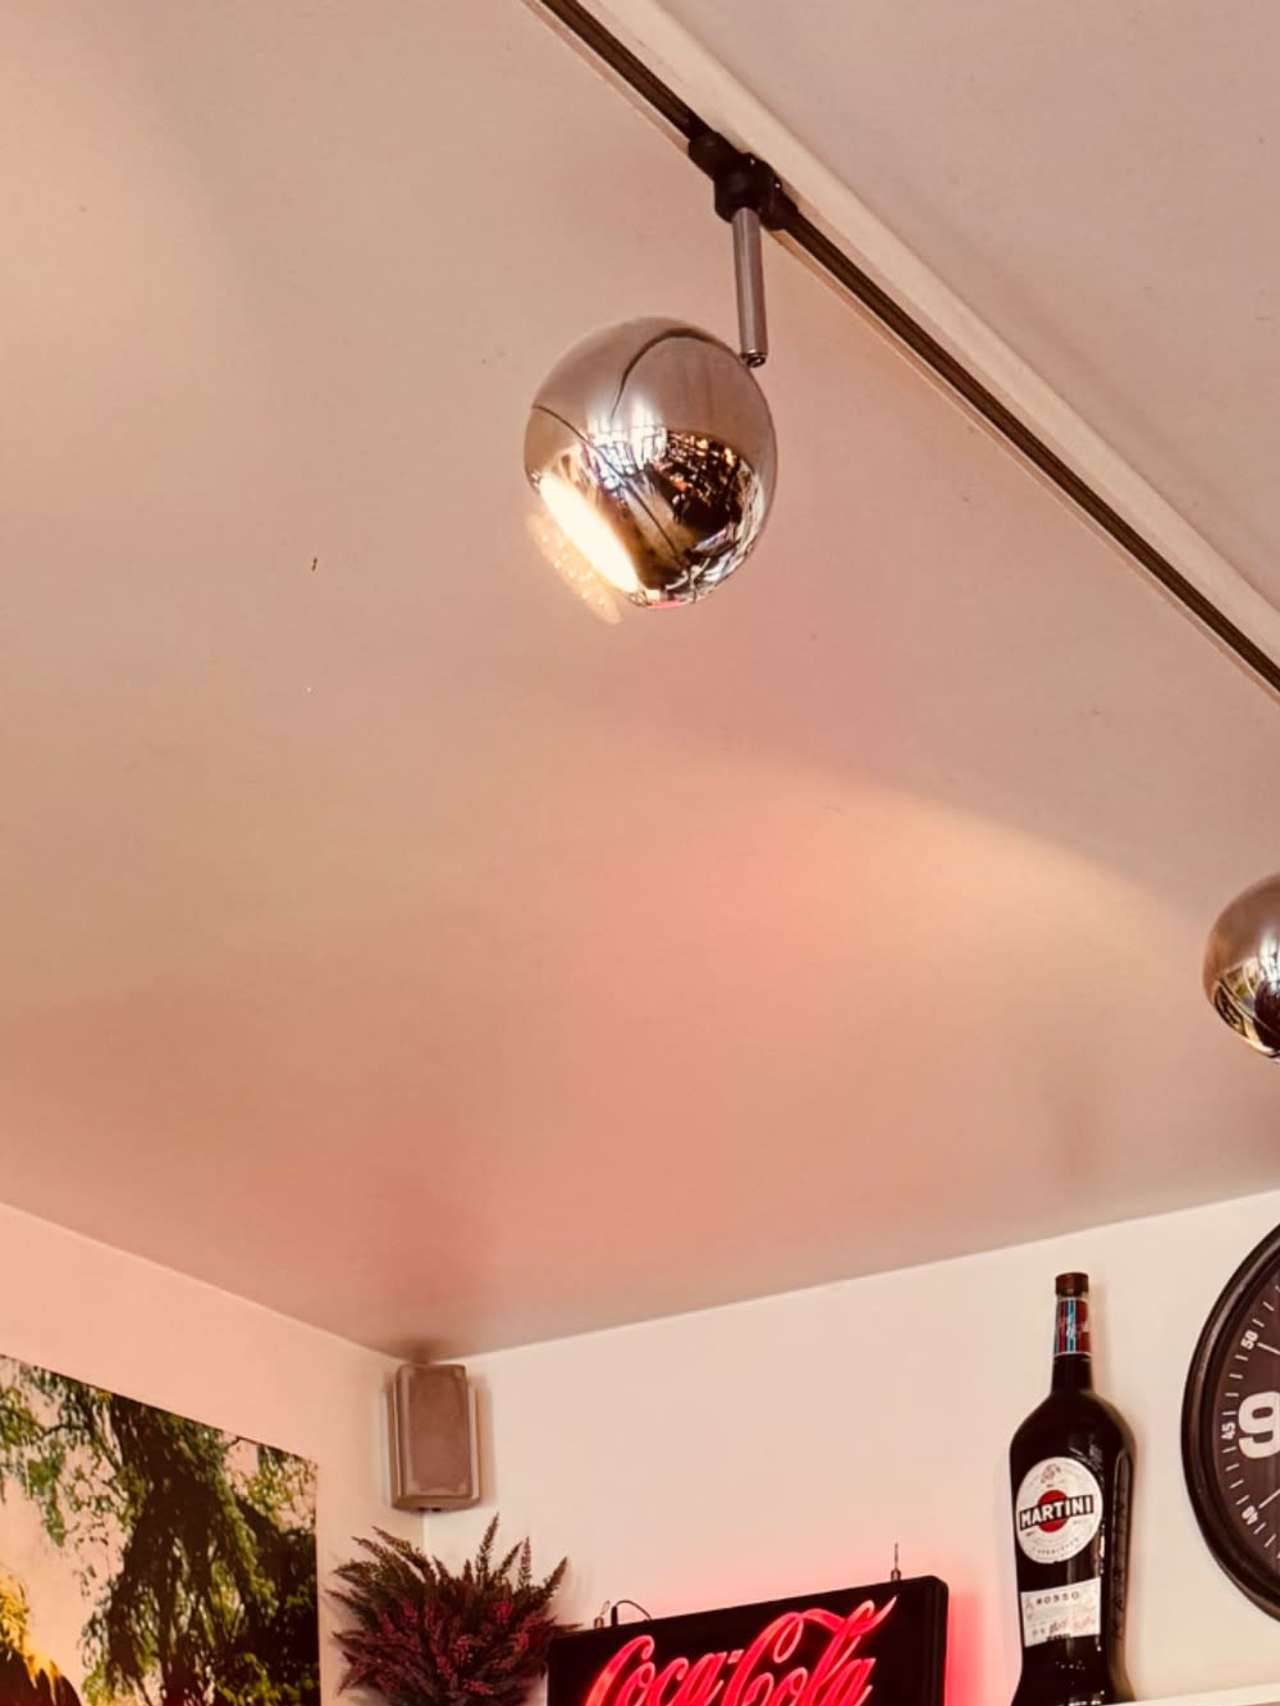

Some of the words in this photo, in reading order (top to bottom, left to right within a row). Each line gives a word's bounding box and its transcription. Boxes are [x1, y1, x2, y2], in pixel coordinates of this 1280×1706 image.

[1242, 1331, 1258, 1349] 50
[1221, 1422, 1235, 1440] 45
[1022, 1495, 1092, 1527] MARTINI
[1242, 1507, 1258, 1524] 40
